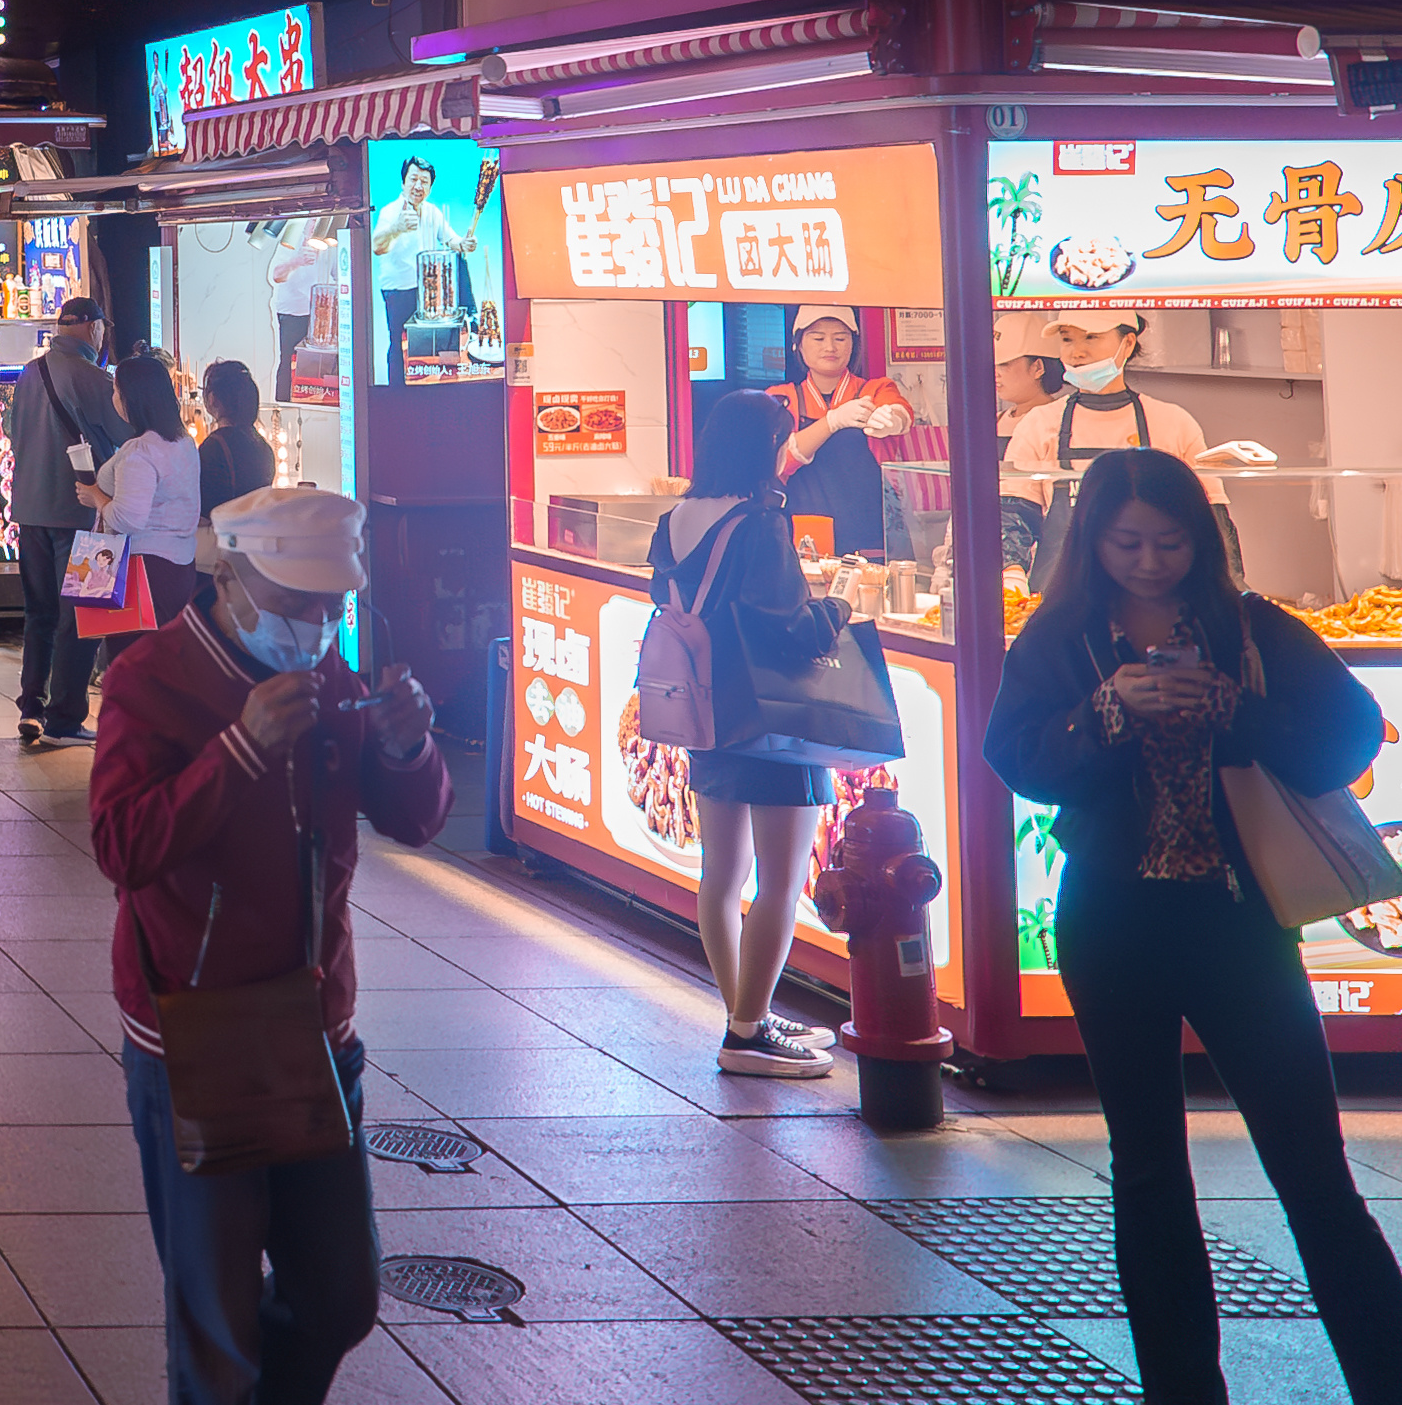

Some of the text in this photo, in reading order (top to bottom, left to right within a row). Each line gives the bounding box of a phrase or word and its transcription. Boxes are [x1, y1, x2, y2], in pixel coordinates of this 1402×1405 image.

[179, 10, 304, 108] 超级大串
[993, 104, 1020, 127] 01
[716, 171, 837, 205] LU DA CHANG
[735, 220, 834, 279] 卤大肠
[456, 362, 492, 375] 王旭东
[522, 616, 591, 687] 现卤
[523, 733, 592, 807] 大肠
[526, 791, 544, 812] HOT
